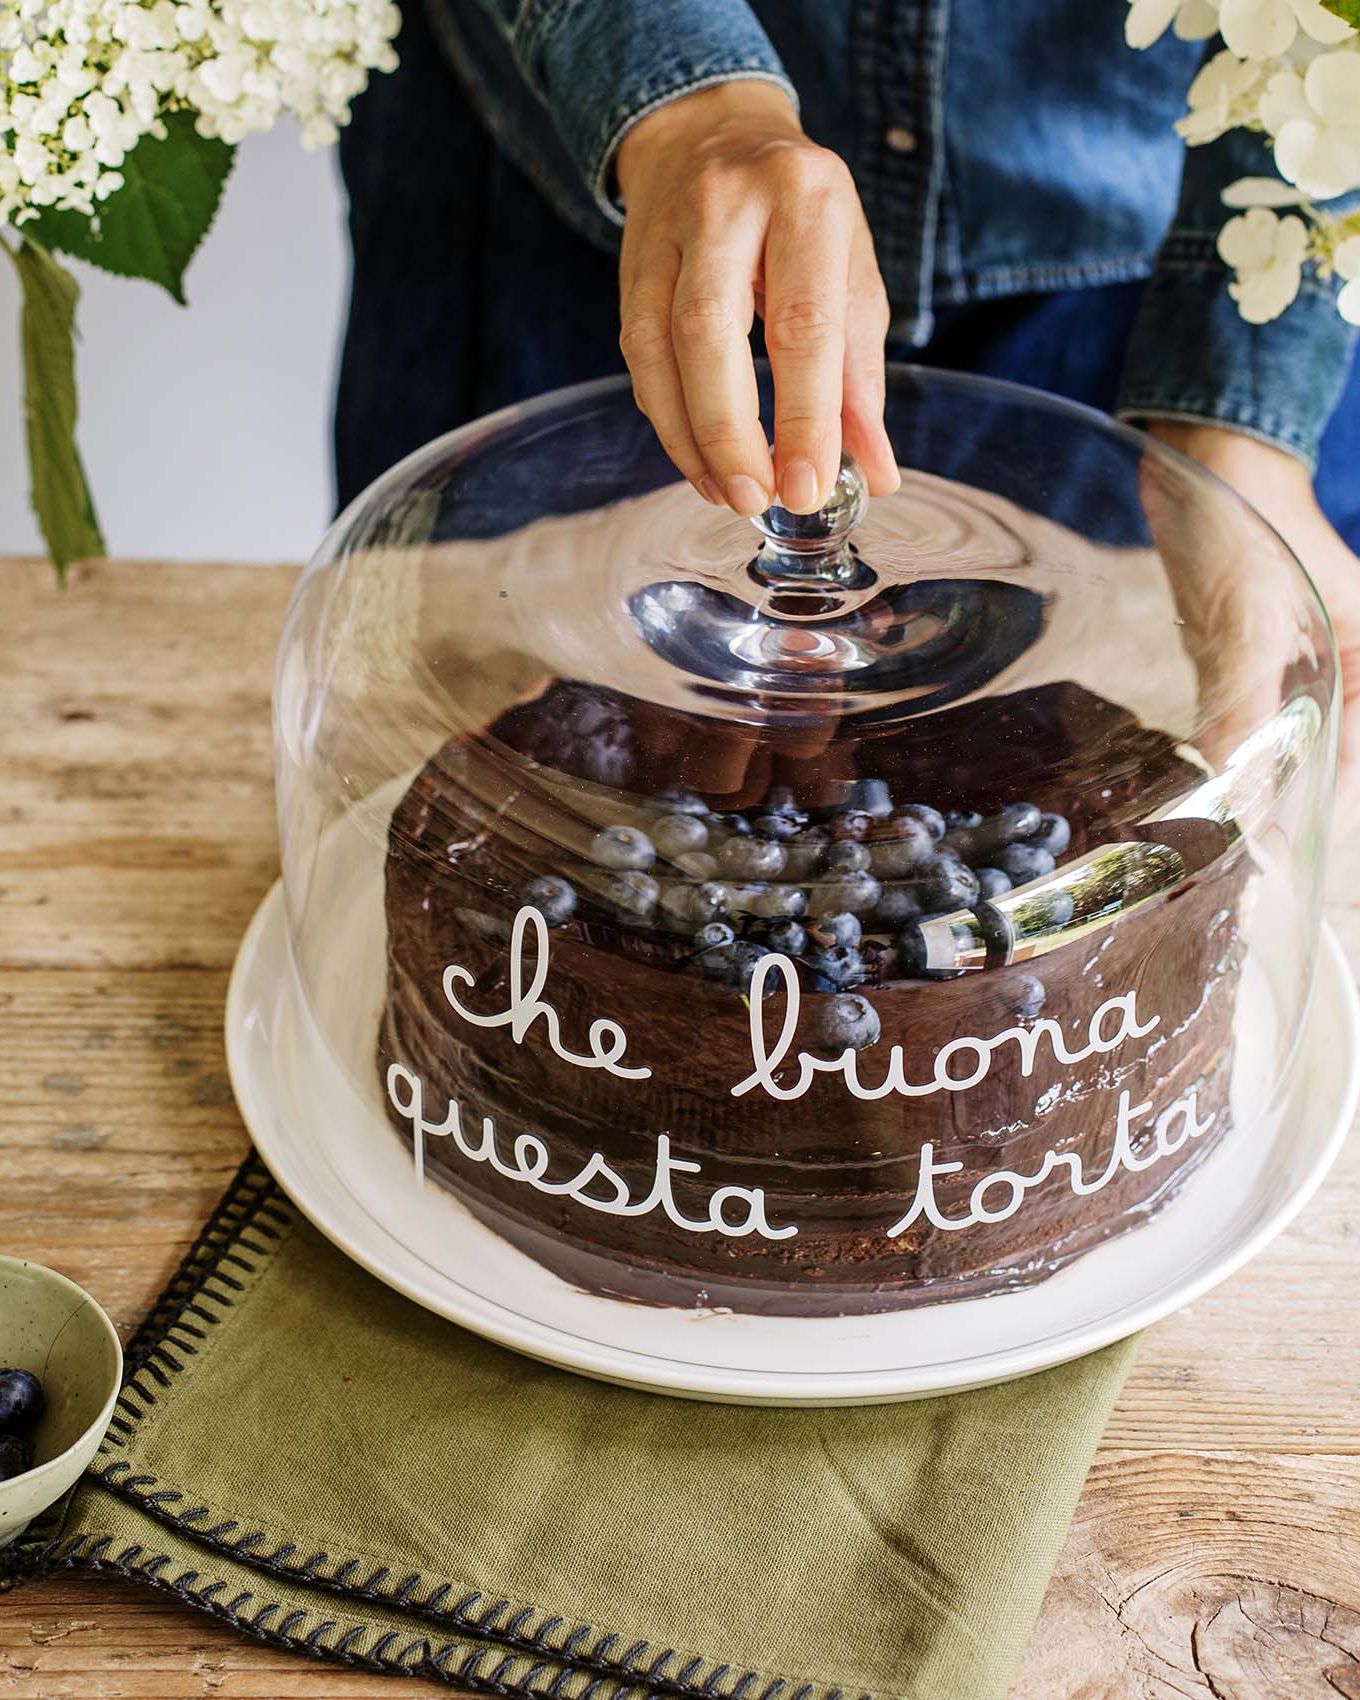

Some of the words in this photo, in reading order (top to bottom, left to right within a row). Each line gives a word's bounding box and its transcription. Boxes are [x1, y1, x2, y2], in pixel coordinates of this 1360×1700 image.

[443, 905, 651, 1080] che
[731, 952, 1160, 1101] buona
[386, 1063, 799, 1240] questa
[886, 1089, 1216, 1239] torta
